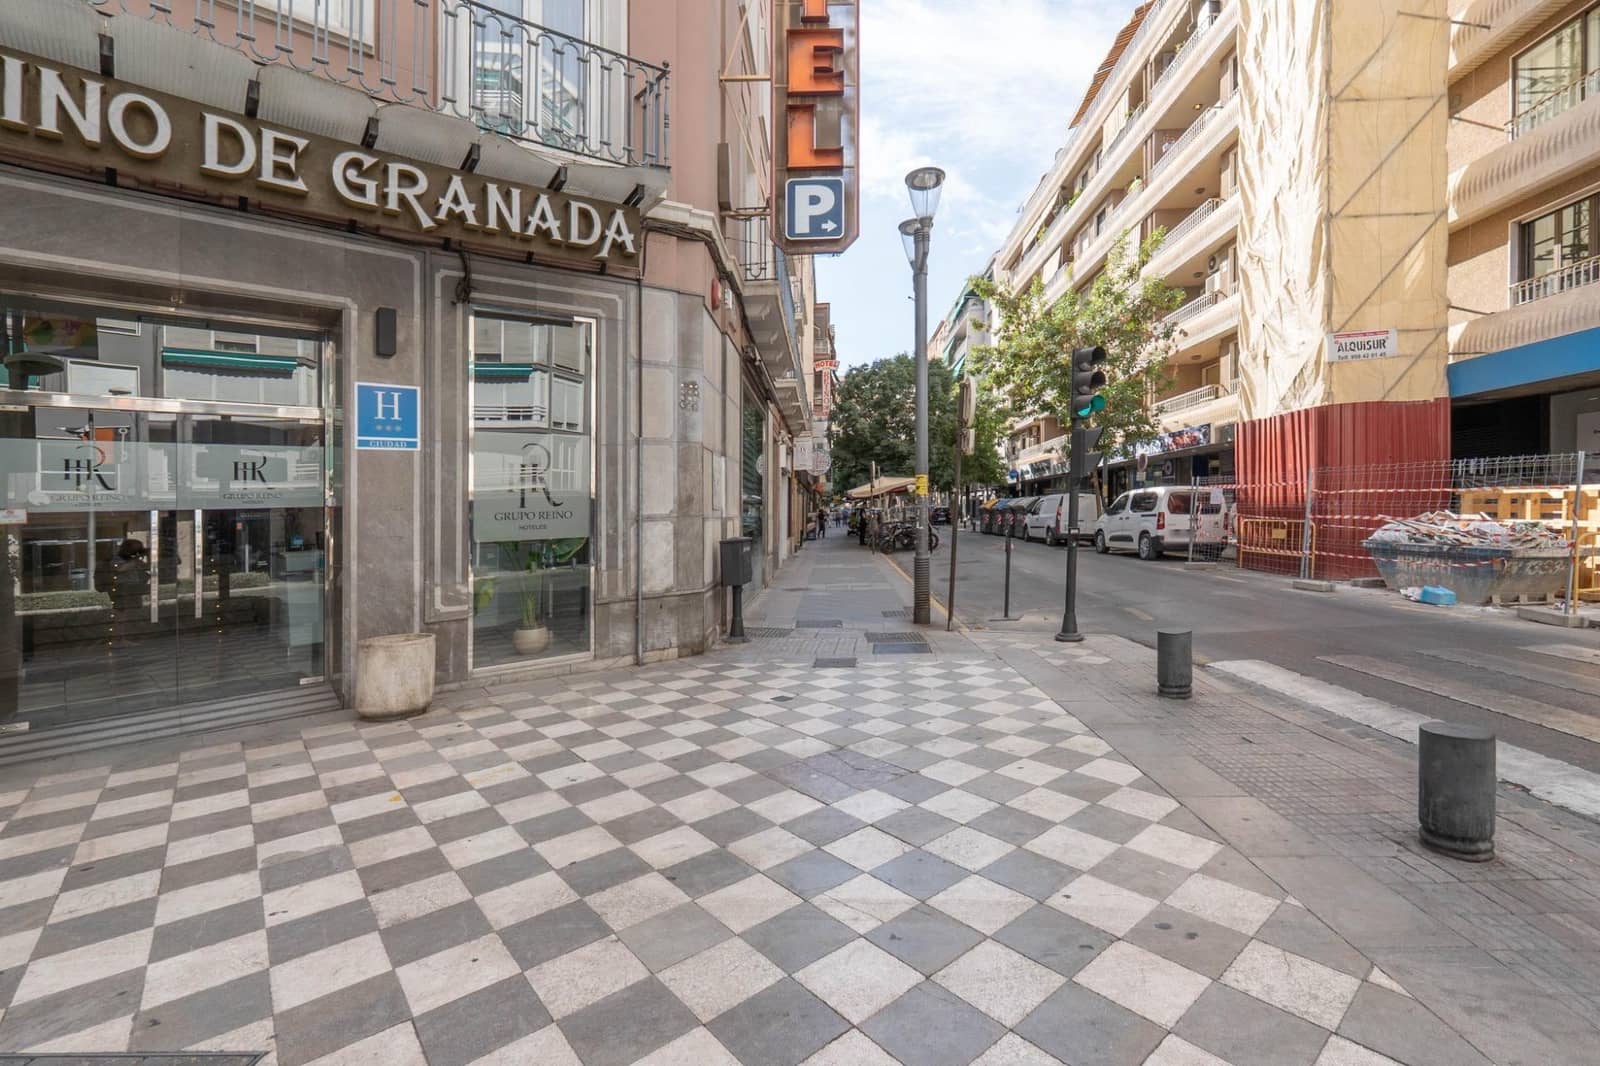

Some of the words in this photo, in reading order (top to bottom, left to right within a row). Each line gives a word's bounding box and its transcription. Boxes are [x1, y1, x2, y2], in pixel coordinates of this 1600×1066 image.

[787, 0, 844, 169] EL
[200, 111, 310, 194] DE
[332, 151, 637, 259] GRANADA
[794, 185, 835, 234] P
[373, 391, 402, 420] H
[369, 440, 408, 448] CIUDAD
[494, 511, 536, 521] GRUPO
[538, 510, 573, 520] REINO
